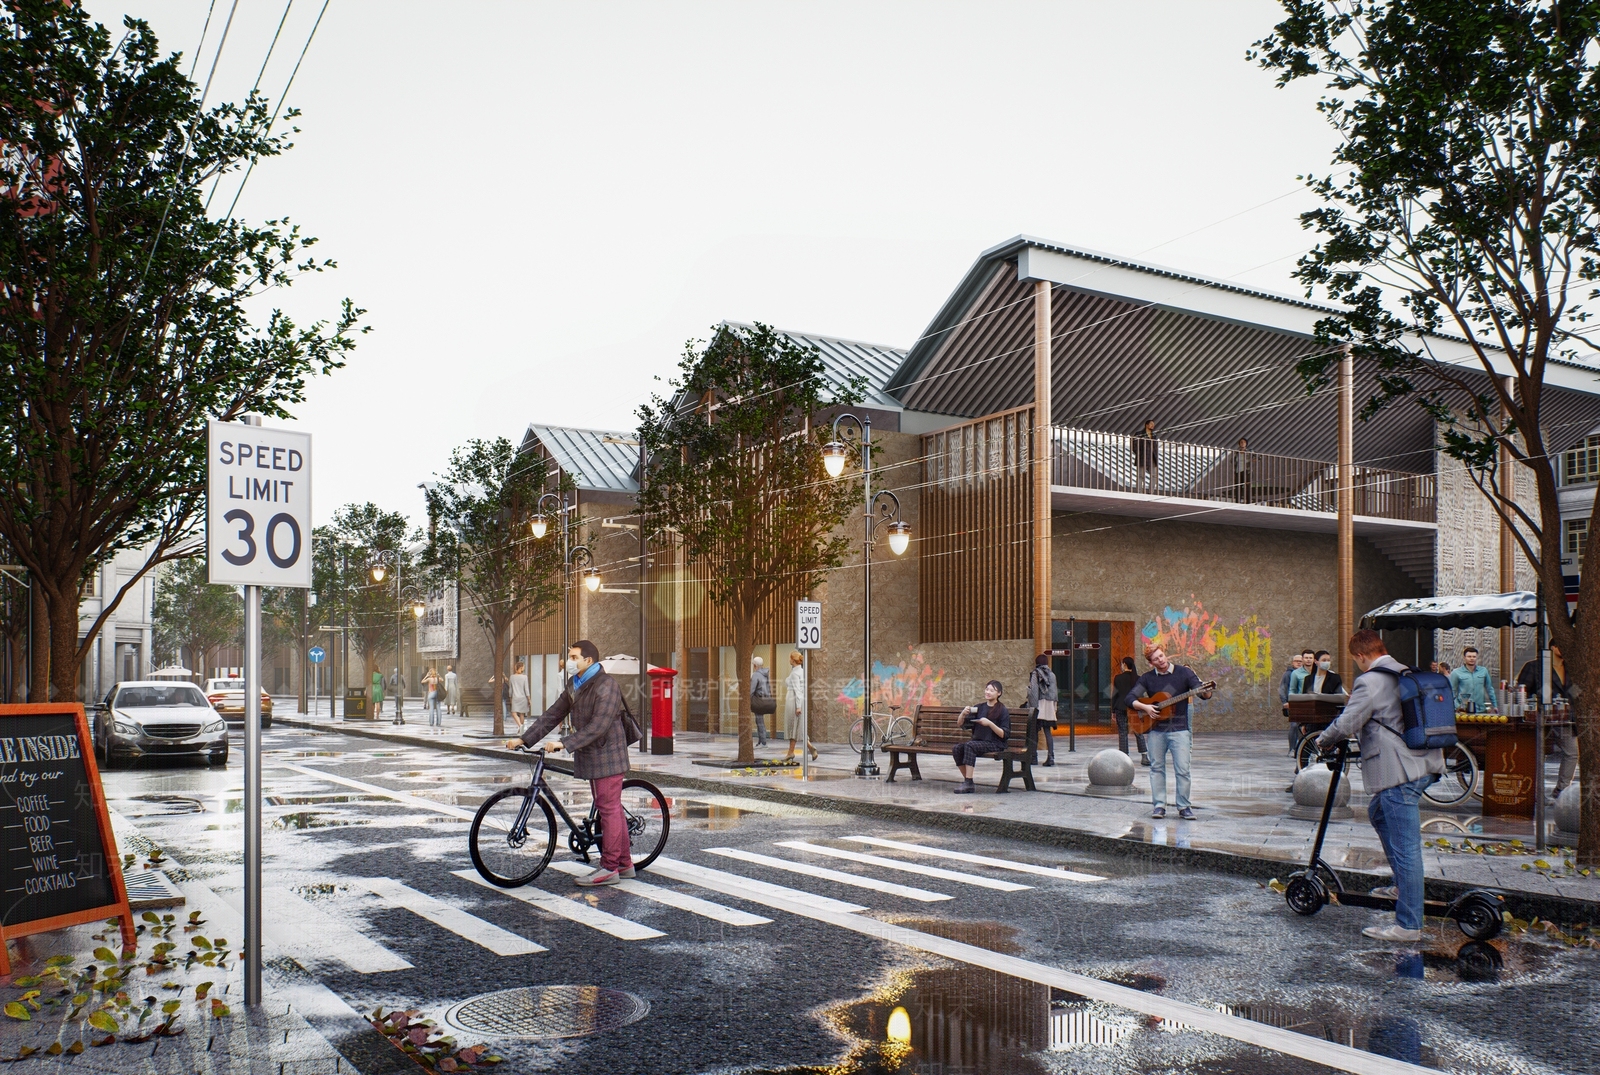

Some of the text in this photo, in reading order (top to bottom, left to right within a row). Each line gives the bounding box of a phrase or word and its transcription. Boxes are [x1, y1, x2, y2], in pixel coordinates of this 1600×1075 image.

[220, 441, 303, 472] SPEED
[229, 475, 294, 503] LIMIT
[221, 508, 302, 569] 30
[800, 606, 820, 614] SPEED
[801, 616, 818, 624] LIMIT
[800, 626, 820, 644] 30
[16, 735, 80, 762] INSIDE
[20, 772, 39, 788] try
[41, 771, 64, 780] our
[17, 795, 50, 813] COFFEE
[24, 816, 50, 833] FOOD
[29, 835, 54, 853] BEER
[32, 855, 59, 872] WINE
[25, 872, 76, 895] COCKTAILS
